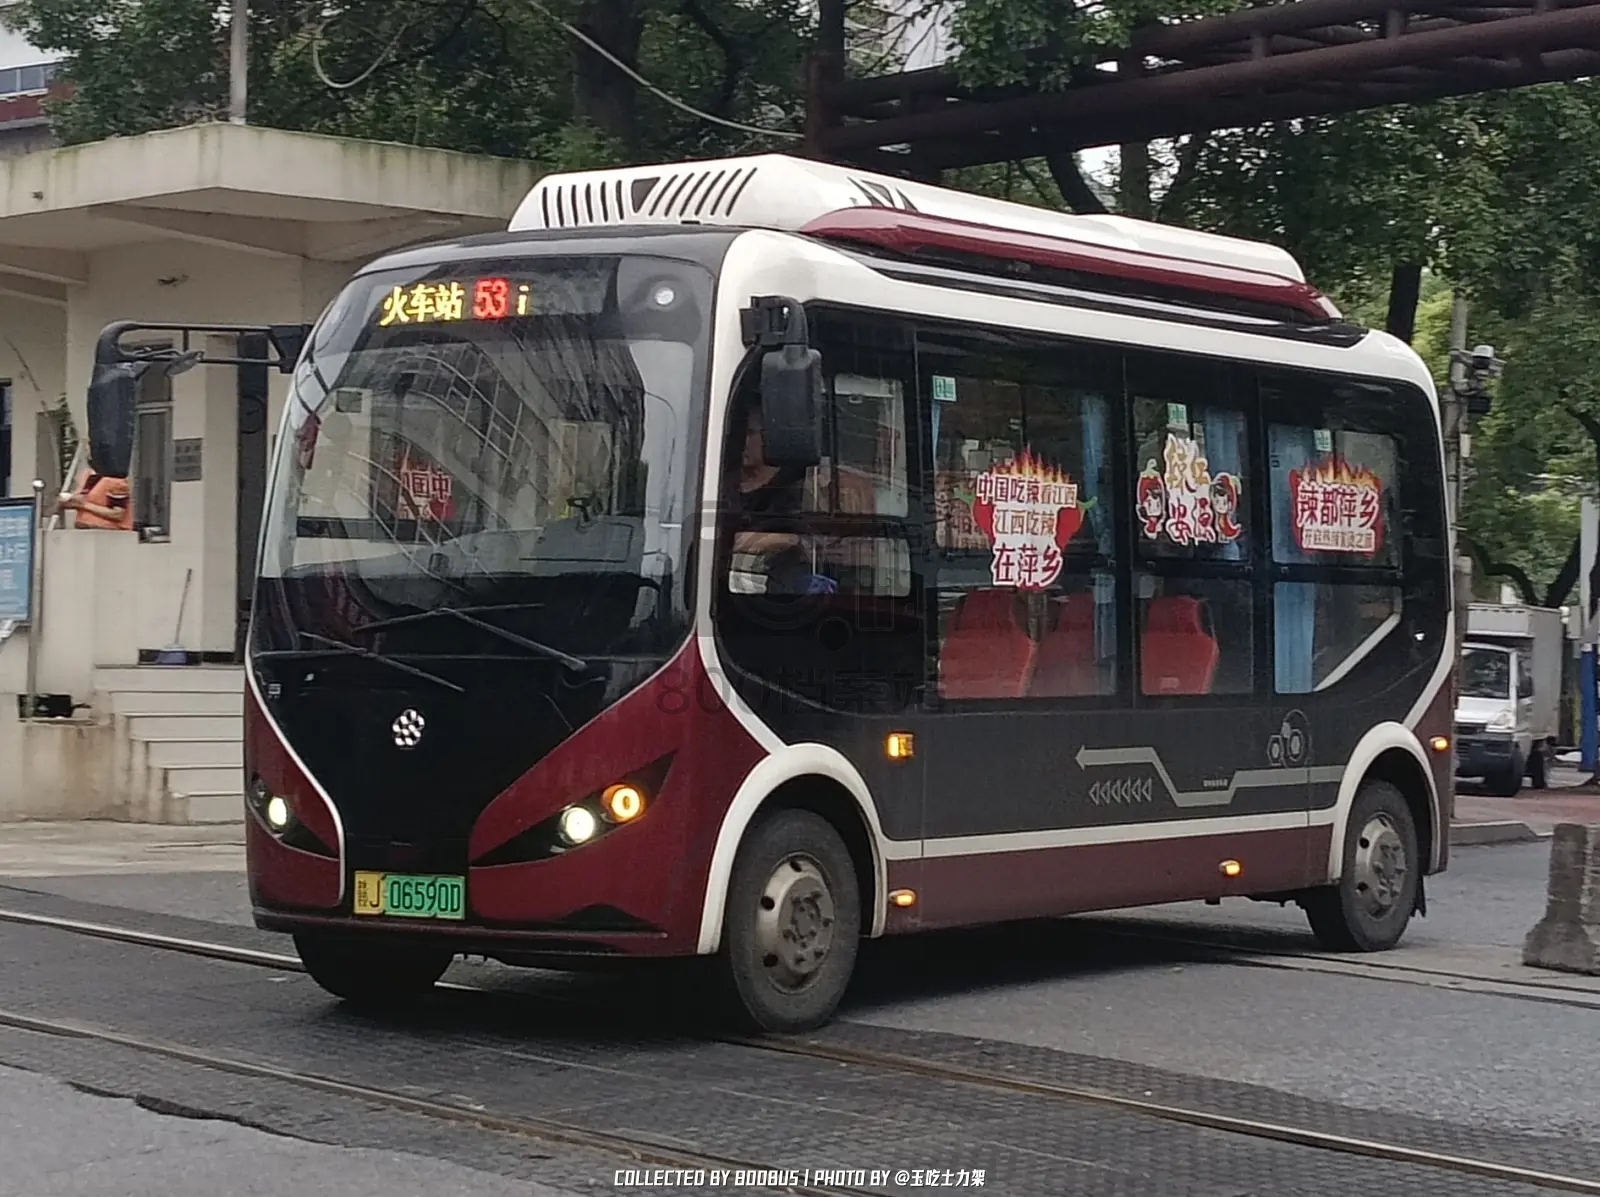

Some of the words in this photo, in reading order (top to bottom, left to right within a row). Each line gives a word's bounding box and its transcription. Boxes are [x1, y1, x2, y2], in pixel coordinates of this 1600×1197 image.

[380, 282, 464, 326] 火车站
[473, 279, 508, 318] 53
[1298, 482, 1378, 528] 辣都萍乡
[993, 541, 1061, 585] 在萍乡
